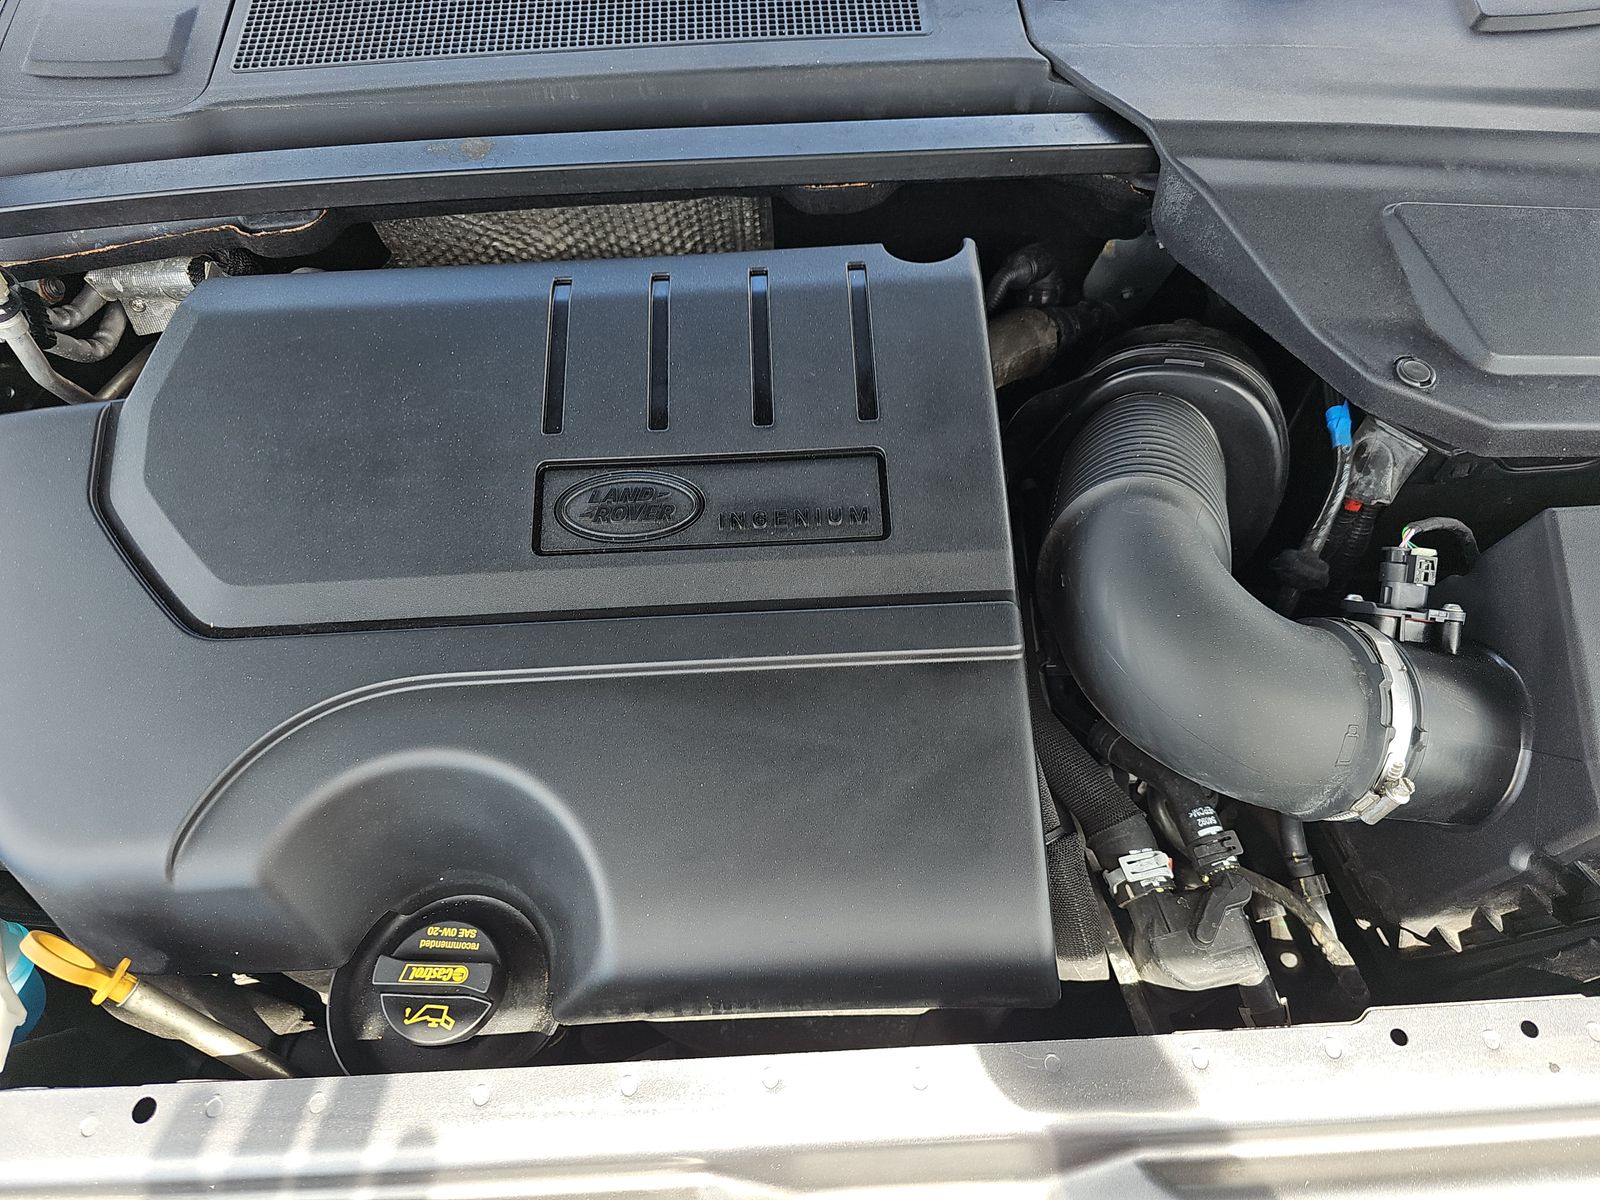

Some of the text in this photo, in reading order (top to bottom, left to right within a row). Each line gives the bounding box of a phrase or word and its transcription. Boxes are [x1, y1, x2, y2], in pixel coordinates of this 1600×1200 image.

[588, 486, 655, 504] LAND
[593, 504, 676, 523] ROVER
[717, 505, 870, 531] INGENIUM
[426, 926, 477, 938] SAE 0W-20
[418, 939, 480, 951] recommended
[408, 966, 455, 982] Castrol
